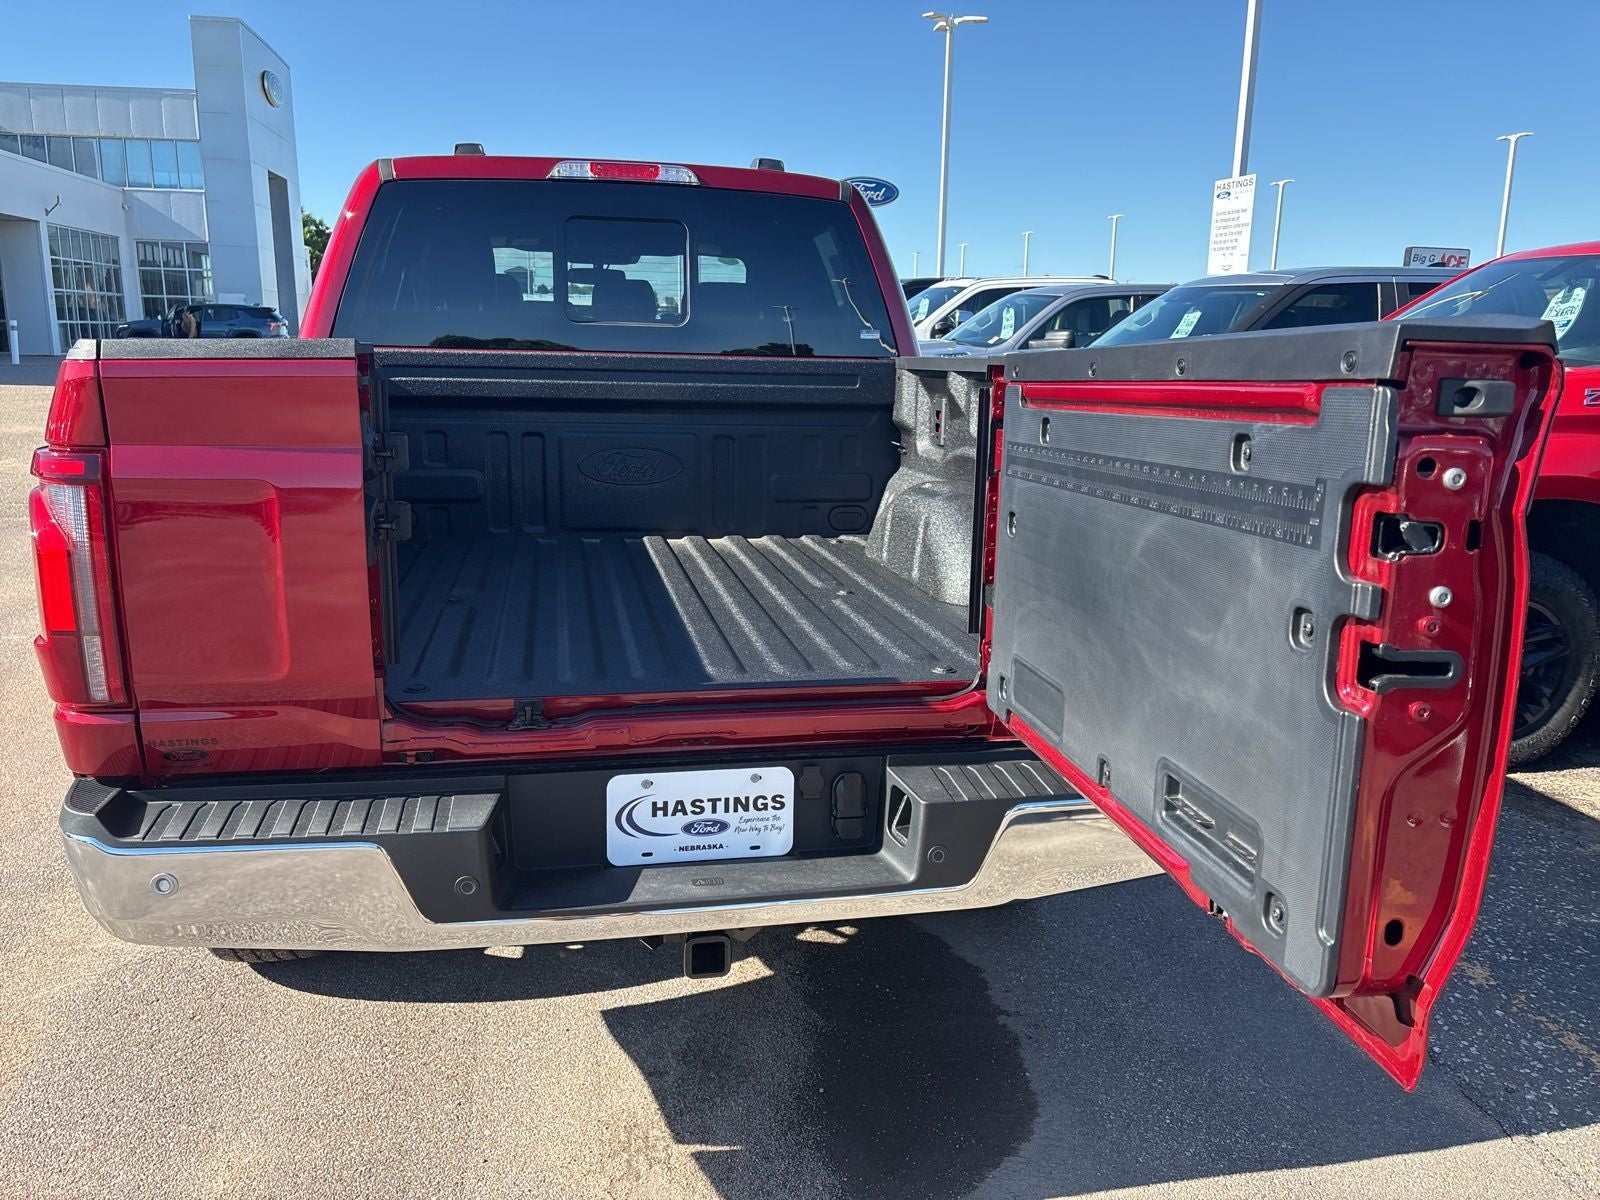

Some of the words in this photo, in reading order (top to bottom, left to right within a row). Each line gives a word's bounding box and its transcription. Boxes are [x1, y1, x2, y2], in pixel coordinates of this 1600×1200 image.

[1216, 178, 1254, 191] HASTINGS
[1412, 253, 1427, 265] Big
[1429, 254, 1436, 263] G
[598, 452, 661, 478] Ford
[147, 738, 218, 748] HASTINGS
[651, 793, 786, 818] HASTINGS
[739, 815, 770, 825] Experience
[690, 820, 720, 834] Ford
[678, 843, 724, 852] NEBRASKA
